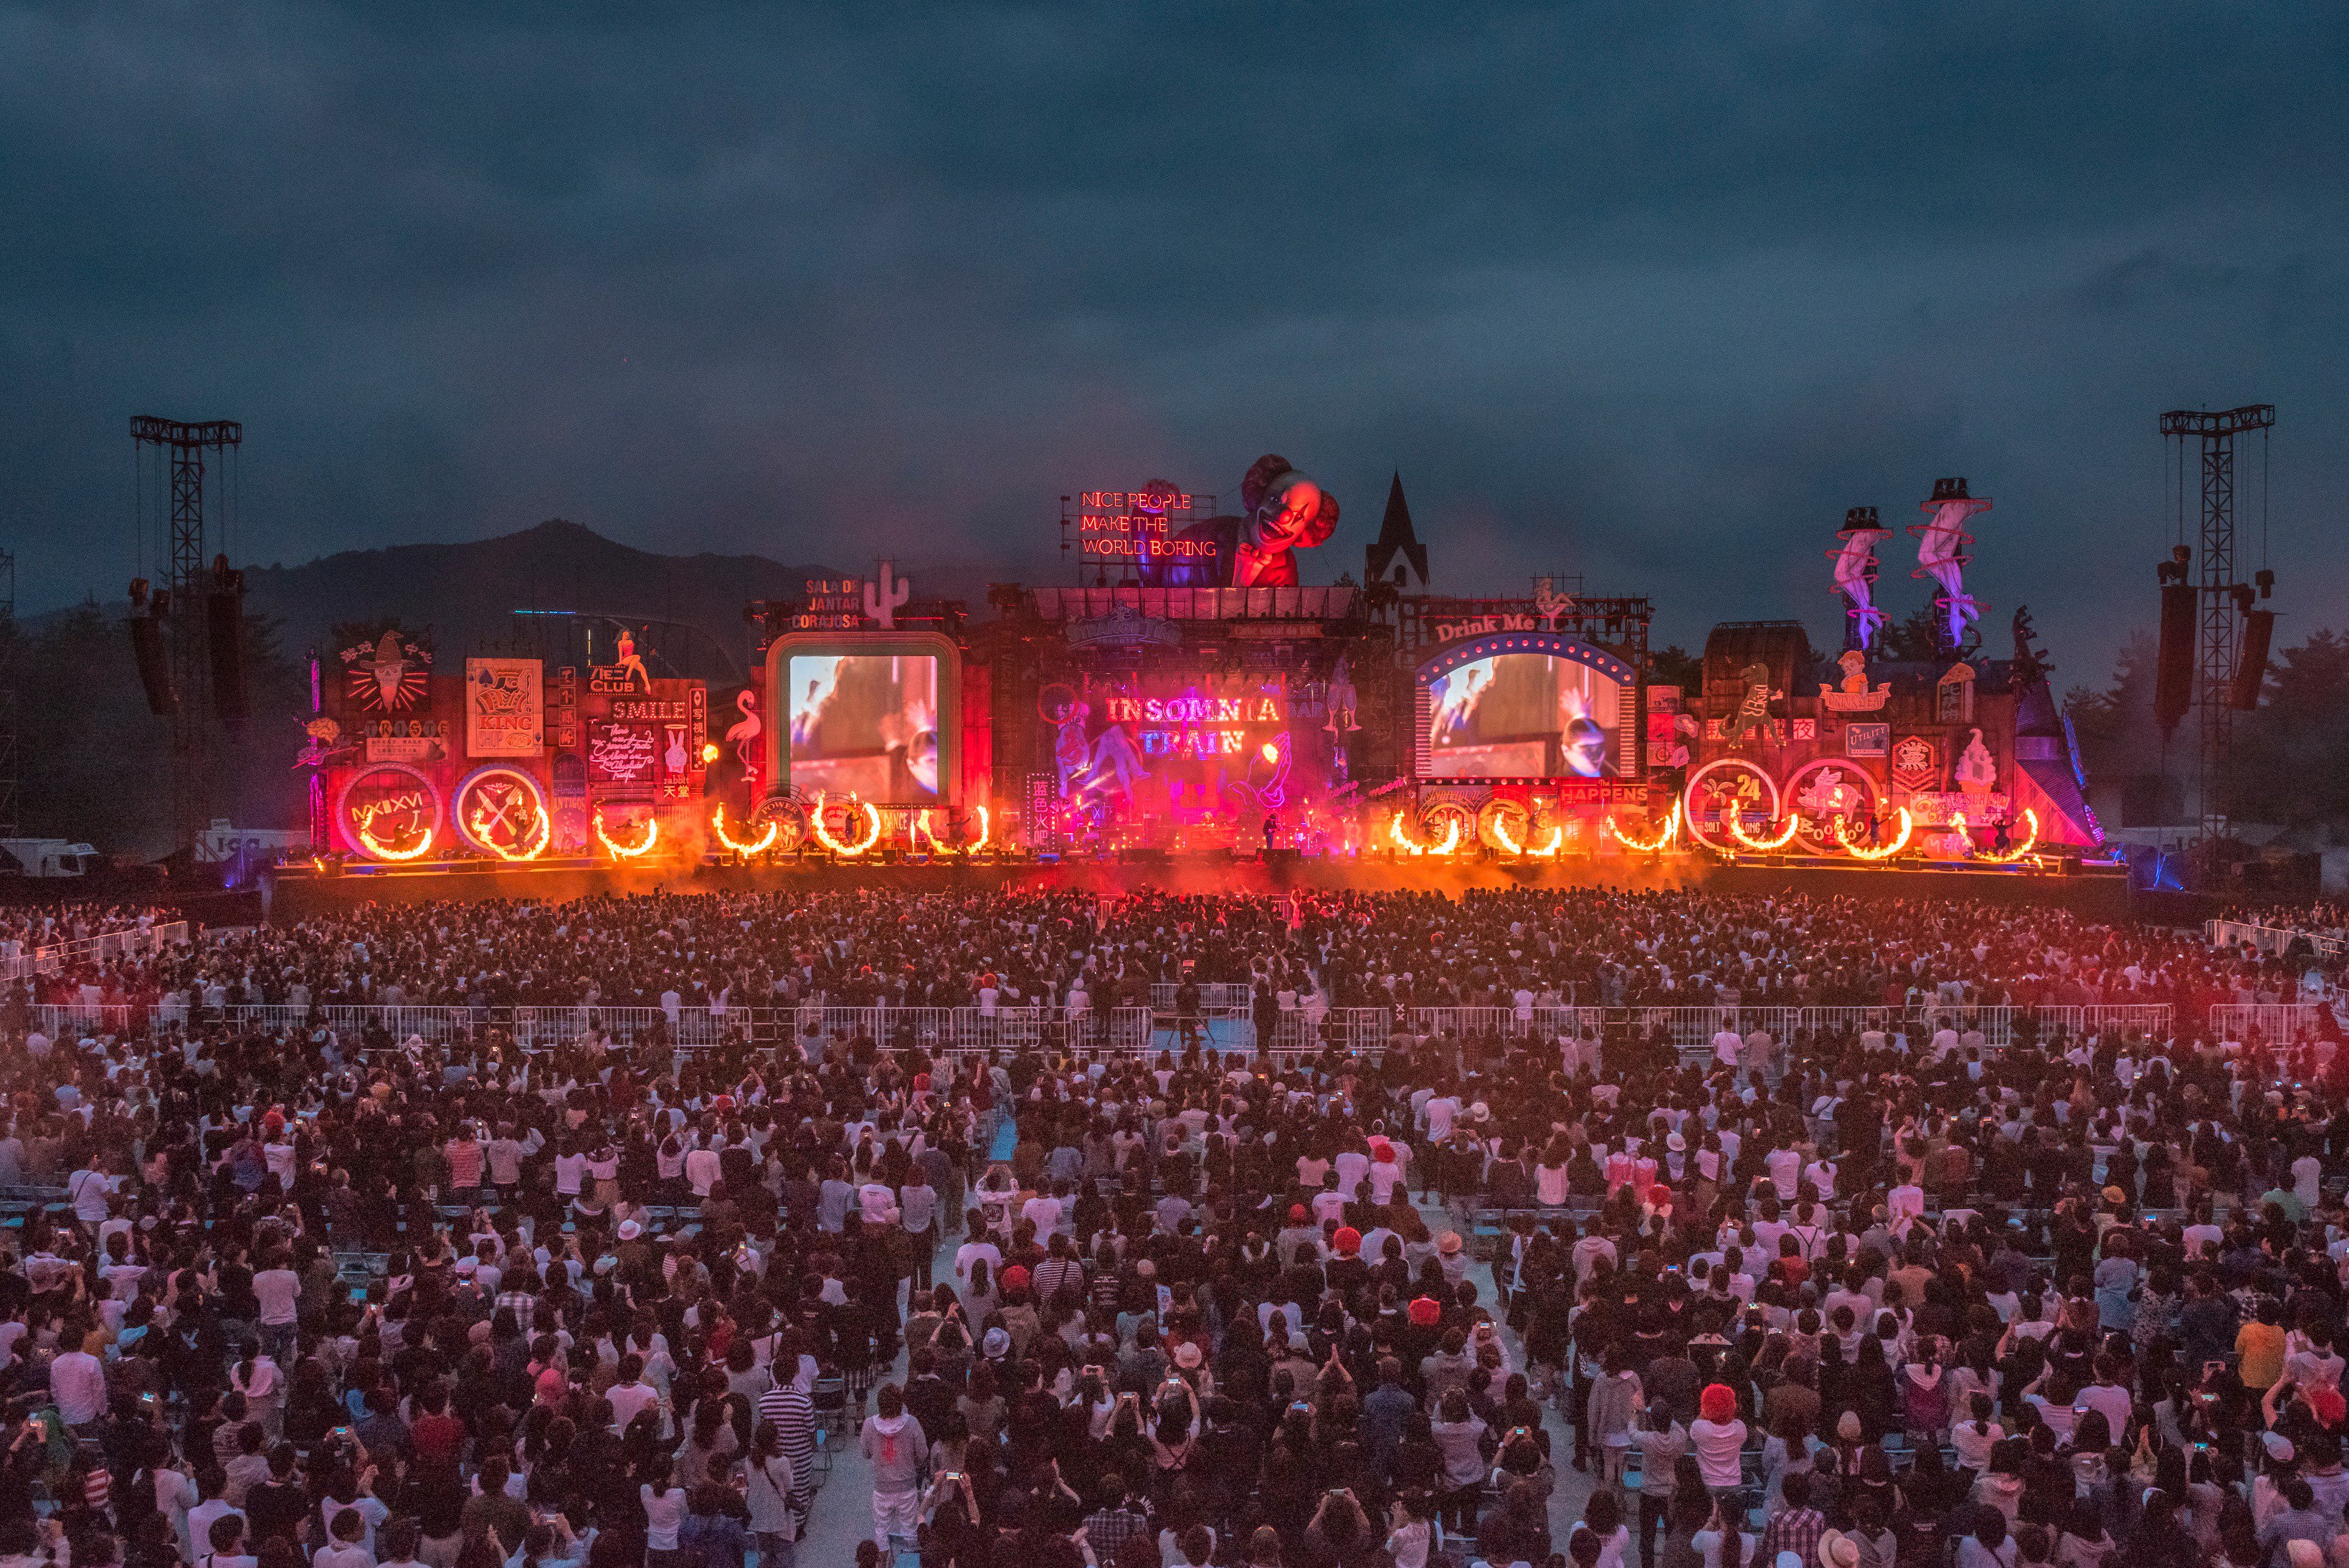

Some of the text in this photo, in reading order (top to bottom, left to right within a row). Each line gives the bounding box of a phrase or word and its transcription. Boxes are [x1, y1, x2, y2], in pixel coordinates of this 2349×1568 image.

[1081, 492, 1192, 509] NICE PEOPLE
[1081, 515, 1169, 532] MAKE THE
[1081, 539, 1217, 556] WORLD BORING
[806, 579, 860, 594] SALA DE
[808, 597, 860, 611] JANTAR
[792, 614, 859, 628] CORAJOSA
[1436, 613, 1536, 642] Drink Me
[1066, 621, 1141, 642] STRANGE
[589, 680, 635, 693] CLUB
[613, 701, 685, 718] SMILE
[1285, 701, 1325, 718] BAR
[1828, 693, 1857, 709] DRINK
[1105, 698, 1280, 722] INSOMNIA
[366, 721, 447, 735] TRISTE
[478, 716, 533, 730] KING
[1139, 730, 1245, 754] TRAIN
[1850, 726, 1885, 746] UTILITY
[554, 784, 585, 797] Amigos
[663, 785, 690, 798] 天堂
[1369, 779, 1405, 797] moon
[1598, 779, 1610, 787] The
[1737, 774, 1762, 801] 24
[1560, 787, 1648, 802] HAPPENS
[554, 797, 587, 813] ANTIGOS
[761, 802, 799, 815] POWER
[1033, 780, 1049, 845] 蓝色火吧
[883, 812, 908, 830] DANCE
